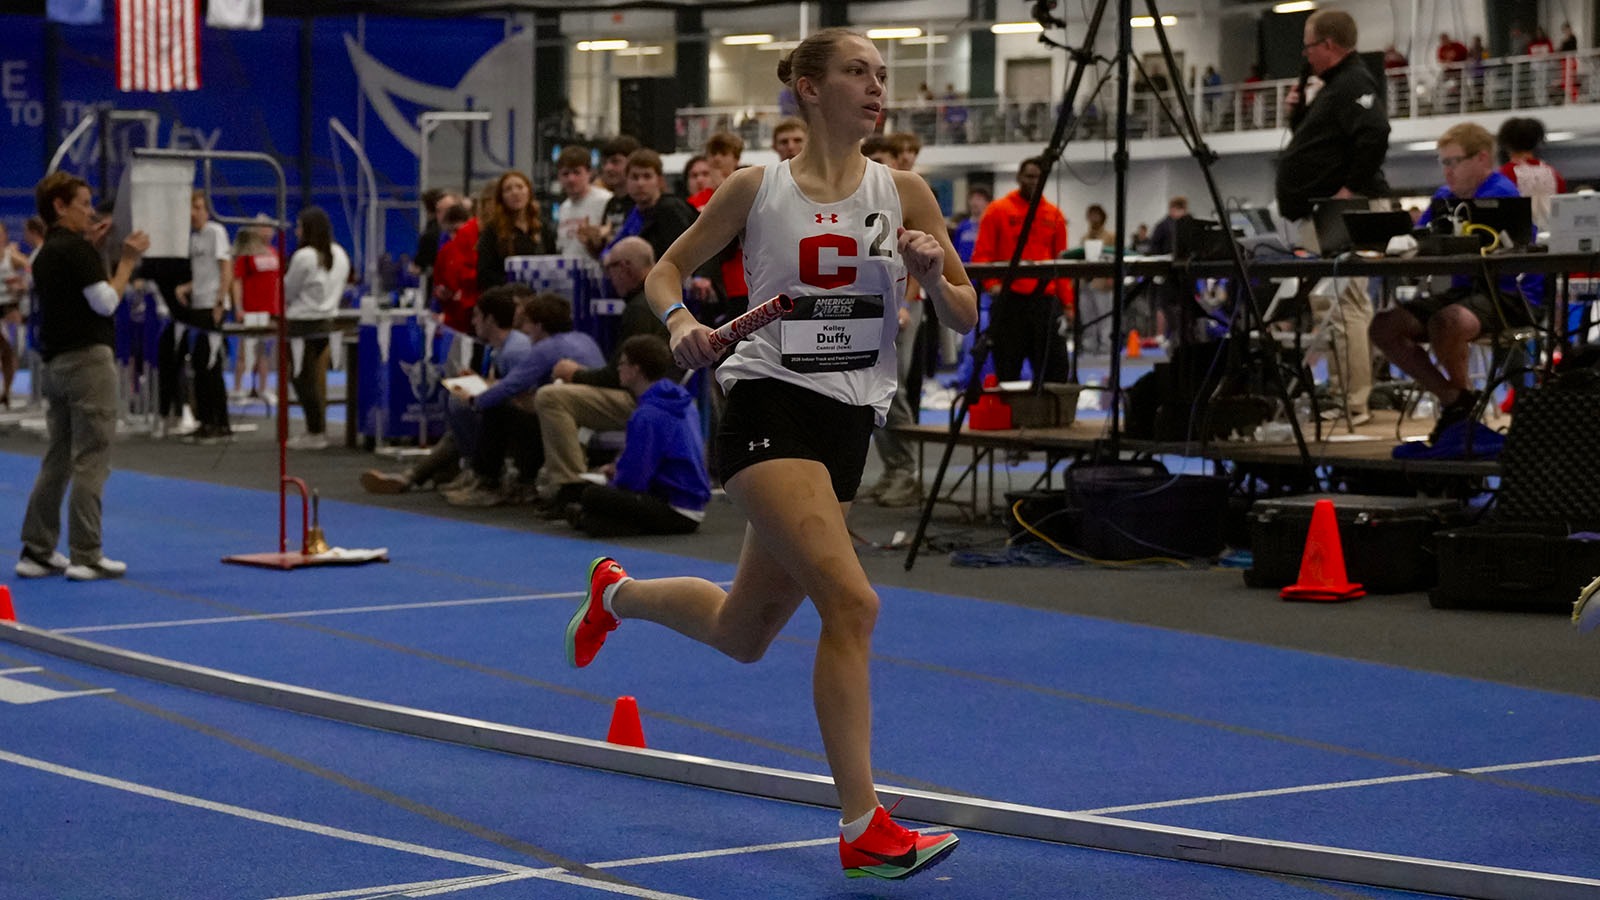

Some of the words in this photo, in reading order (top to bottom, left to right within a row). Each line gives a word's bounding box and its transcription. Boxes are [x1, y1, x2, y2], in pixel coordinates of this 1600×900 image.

[7, 101, 43, 126] TO
[864, 212, 893, 258] 2
[799, 233, 858, 290] C
[817, 333, 851, 345] Duffy
